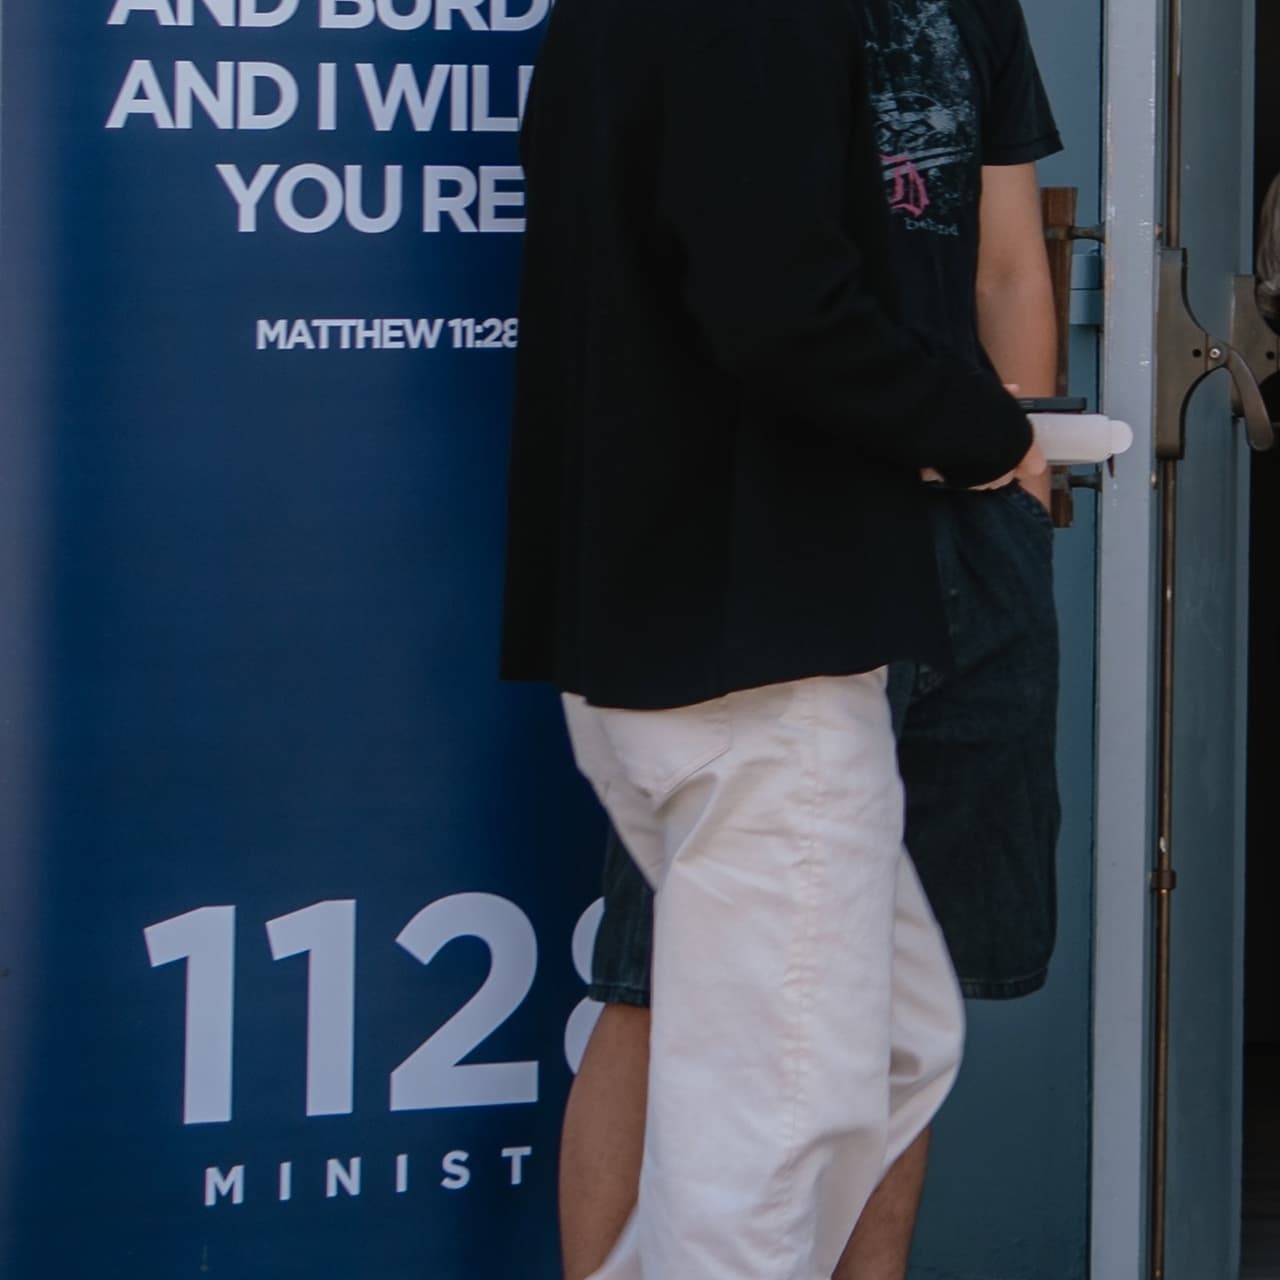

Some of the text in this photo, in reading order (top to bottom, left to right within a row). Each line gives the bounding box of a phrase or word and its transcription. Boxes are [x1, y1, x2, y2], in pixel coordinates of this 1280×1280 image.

[104, 59, 299, 130] AND
[317, 62, 337, 131] I
[215, 163, 527, 234] YOU RE
[255, 317, 519, 351] MATTHEW 11:28
[204, 1146, 532, 1206] MINIST
